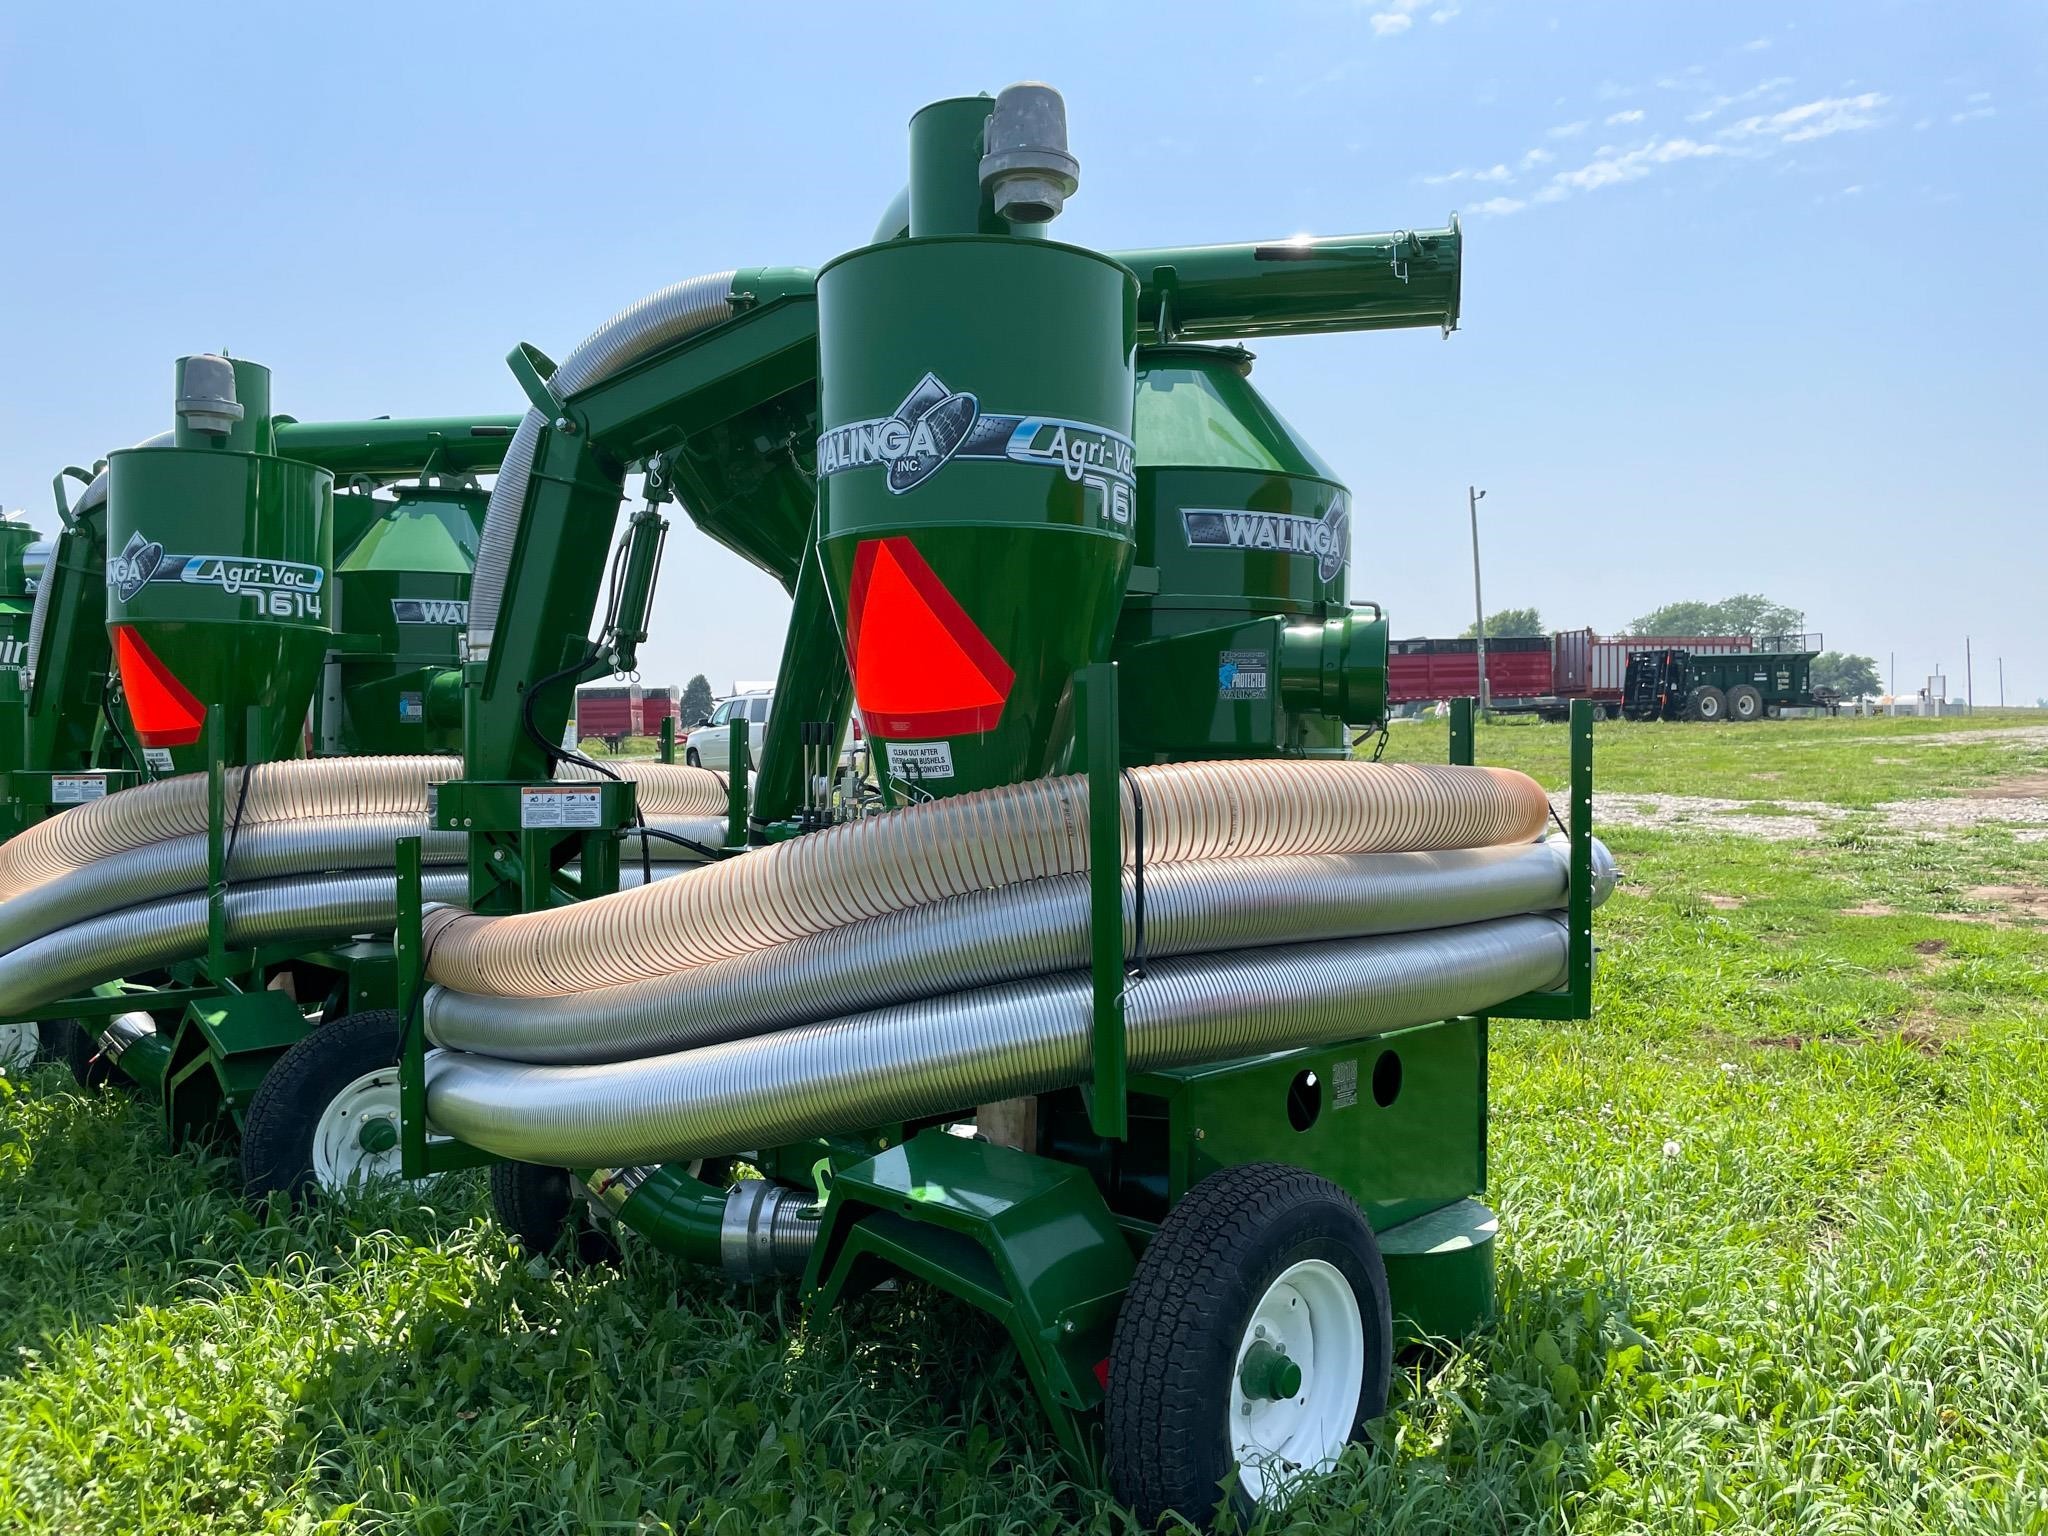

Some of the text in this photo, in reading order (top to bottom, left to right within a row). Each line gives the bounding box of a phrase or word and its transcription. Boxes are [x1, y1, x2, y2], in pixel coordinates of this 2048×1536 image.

[897, 460, 921, 472] INC.
[1083, 474, 1136, 527] 761
[1224, 513, 1340, 557] WALINGA
[107, 557, 141, 584] NGA
[211, 560, 304, 593] Agri-Vac
[241, 589, 321, 620] 7614
[1231, 672, 1266, 688] PROTECTED
[919, 756, 945, 764] BUSHELS
[920, 748, 938, 756] AFTER
[920, 765, 950, 773] CONVEYED
